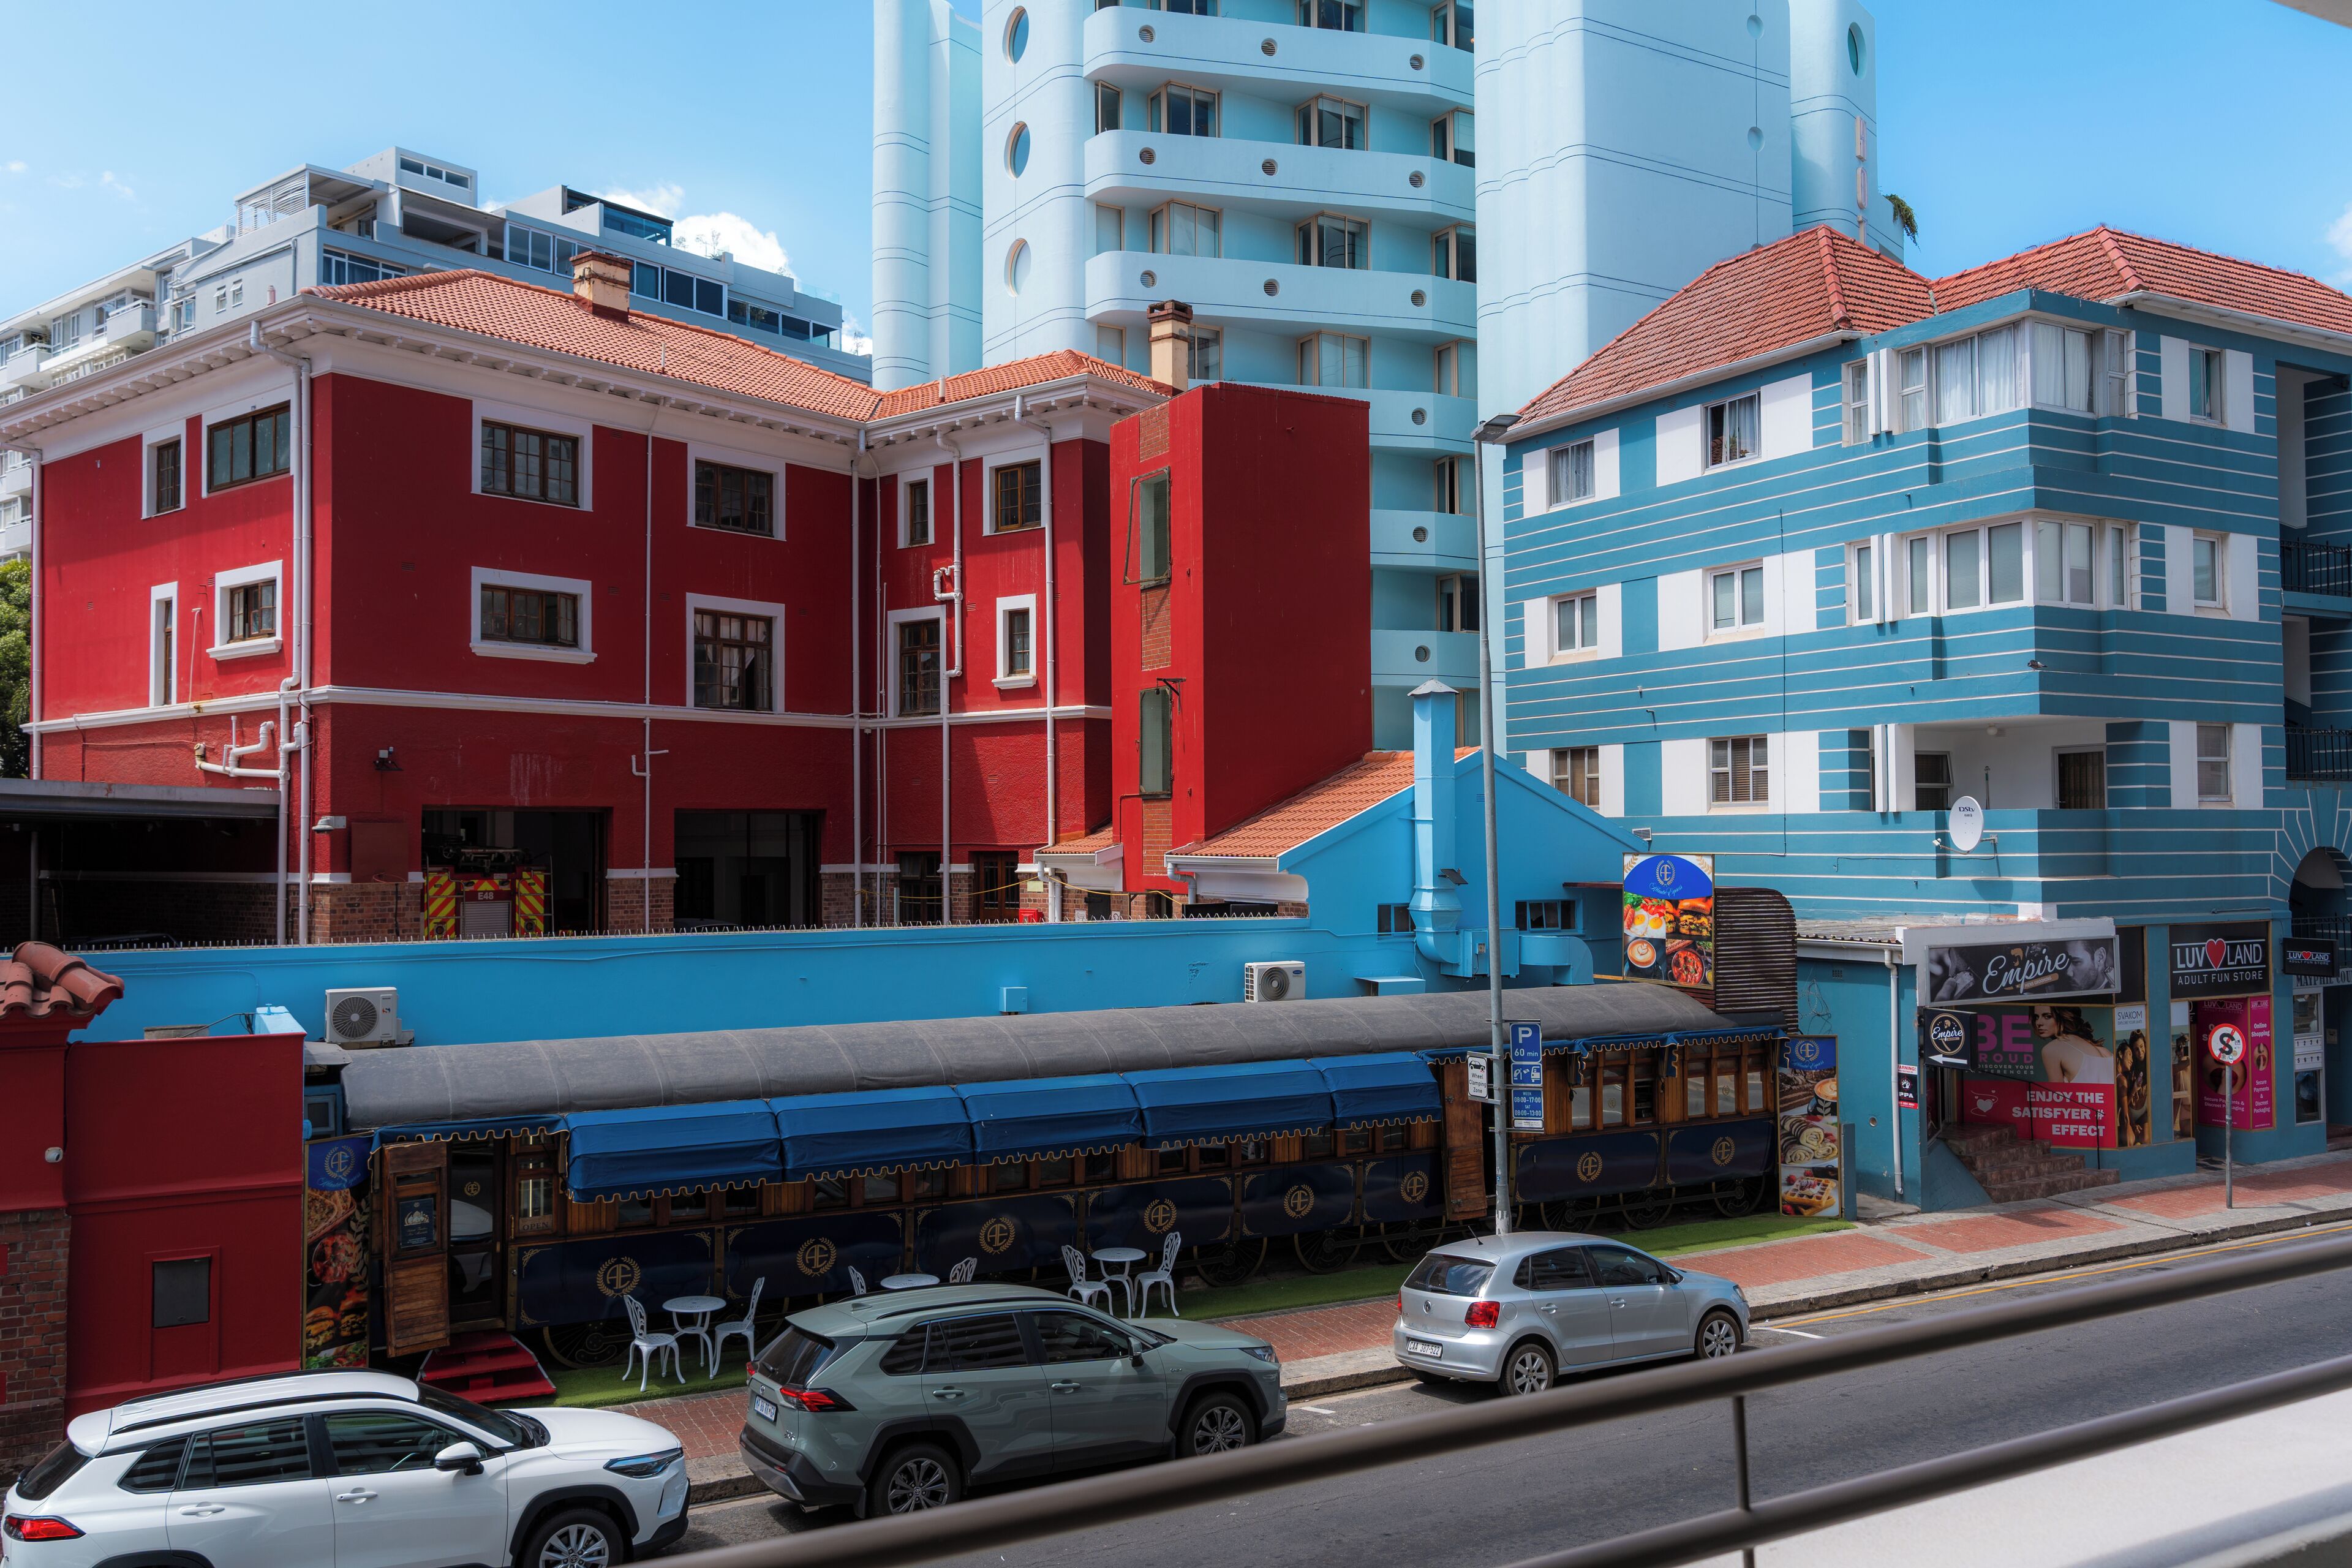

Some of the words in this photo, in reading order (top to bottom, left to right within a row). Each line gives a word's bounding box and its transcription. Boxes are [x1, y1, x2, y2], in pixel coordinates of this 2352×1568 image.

[478, 892, 494, 900] E48
[2176, 946, 2205, 969] LUV
[2227, 943, 2263, 965] LAND
[1982, 948, 2071, 994] Empire
[2034, 976, 2052, 985] GROOMING
[2177, 974, 2208, 986] ADULT
[2211, 973, 2230, 983] FUN
[2233, 970, 2263, 981] STORE
[2117, 1011, 2143, 1020] SVAKOM
[1518, 1027, 1532, 1044] P
[1931, 1027, 1964, 1042] Empire
[1978, 1014, 2034, 1052] BE
[2218, 1032, 2236, 1055] S
[1514, 1048, 1525, 1057] 60
[1979, 1053, 2034, 1064] ROUD
[1469, 1079, 1487, 1088] Clamping
[2027, 1091, 2072, 1103] ENJOY
[2076, 1092, 2104, 1103] THE
[2012, 1106, 2091, 1120] SATISFYER
[2095, 1109, 2105, 1120] #
[2052, 1124, 2105, 1137] EFFECT
[522, 1221, 549, 1231] OPEN
[1409, 1341, 1419, 1351] CAA
[1420, 1343, 1441, 1355] 387-522
